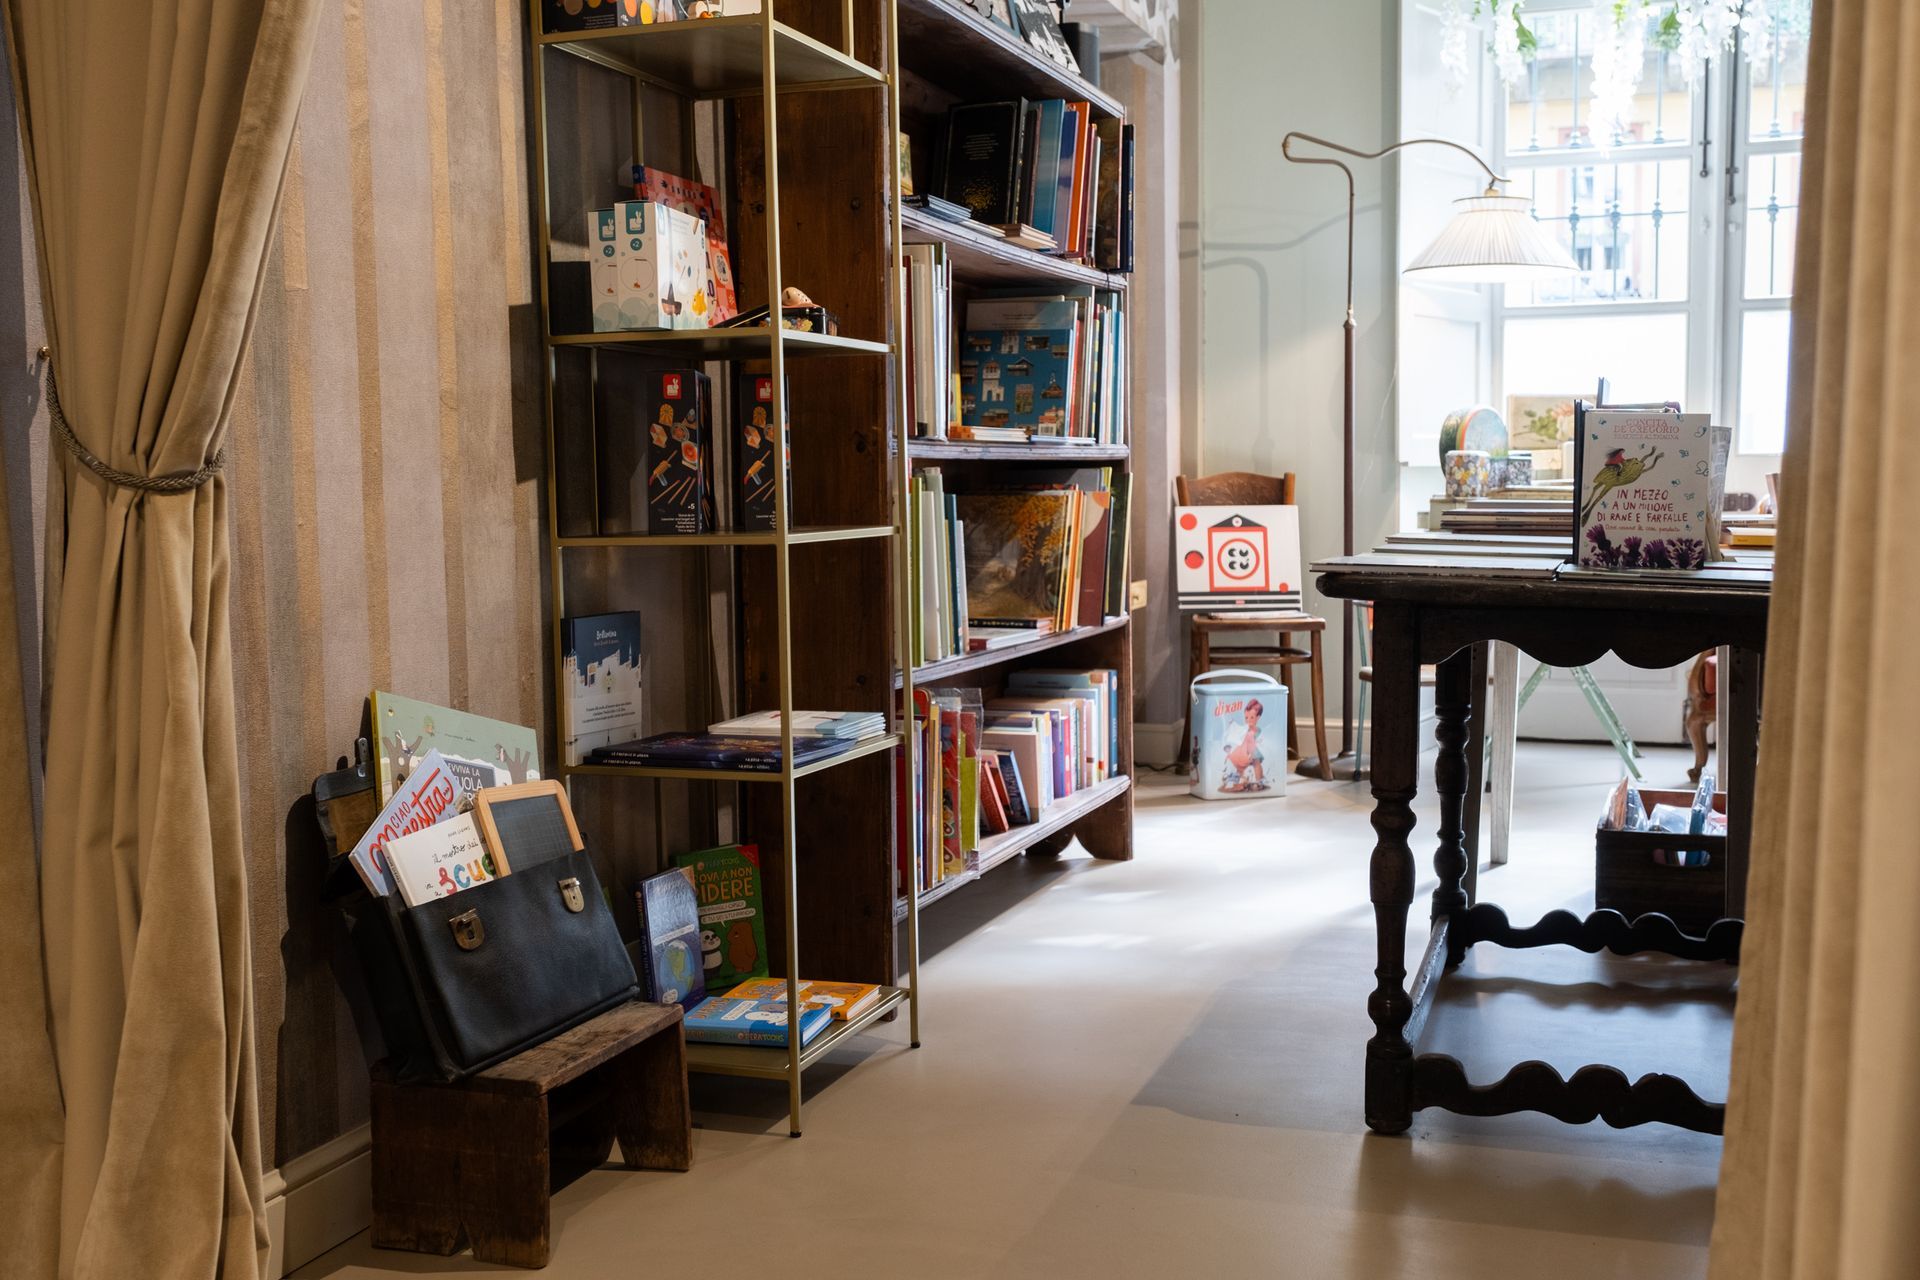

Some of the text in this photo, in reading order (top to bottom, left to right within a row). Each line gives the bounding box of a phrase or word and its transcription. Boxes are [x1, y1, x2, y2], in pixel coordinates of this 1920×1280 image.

[1630, 425, 1680, 434] GREGORIO
[1617, 488, 1669, 501] IN MEZZO
[1612, 501, 1674, 512] A UN MILIONE
[1597, 511, 1688, 523] DI RANE E FARFALLE
[1214, 700, 1243, 717] dixan
[471, 768, 480, 777] LA
[389, 801, 411, 829] CIAO
[730, 866, 752, 878] NON
[697, 877, 754, 904] IDERE
